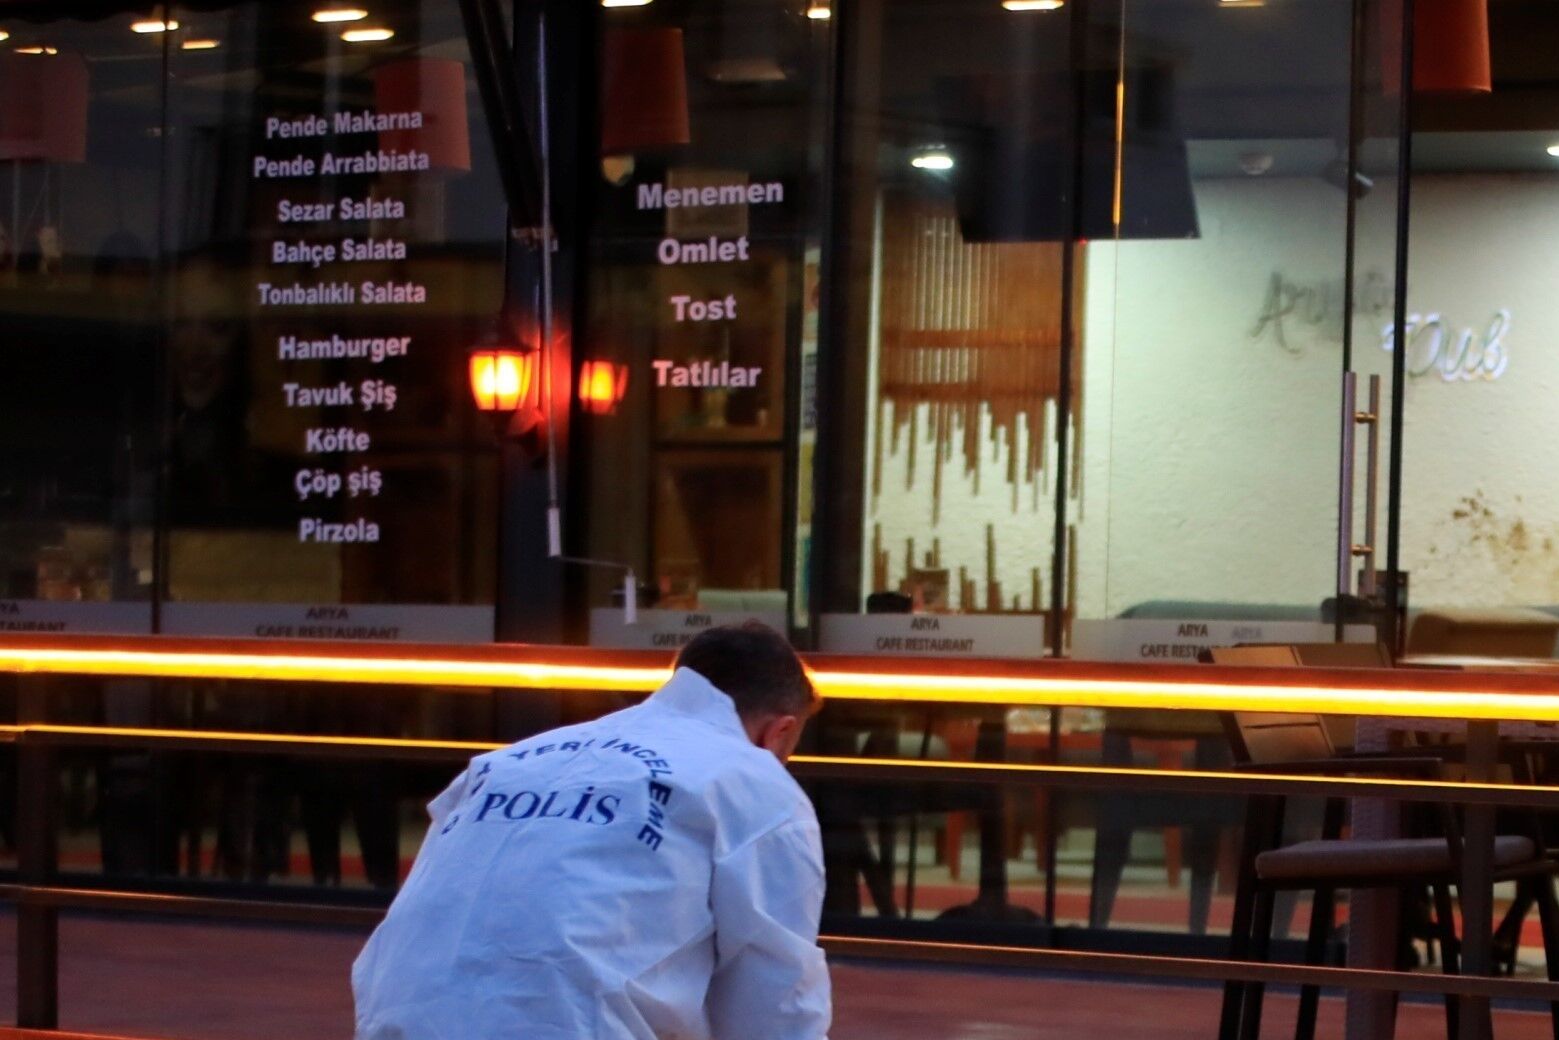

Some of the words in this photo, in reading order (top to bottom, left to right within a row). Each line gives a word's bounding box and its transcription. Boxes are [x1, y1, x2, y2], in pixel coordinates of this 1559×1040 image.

[266, 114, 328, 139] Pende
[334, 110, 422, 135] Makarna
[254, 154, 315, 178] Pende
[320, 150, 429, 176] Arrabbiata
[278, 200, 335, 222] Sezar
[340, 198, 405, 220] Salata
[637, 182, 784, 210] Menemen
[272, 241, 336, 268] Bahçe
[341, 239, 407, 261] Salata
[658, 235, 749, 265] Omlet
[361, 281, 427, 304] Salata
[671, 294, 737, 322] Tost
[278, 335, 411, 363] Hamburger
[283, 381, 354, 407] Tavuk
[360, 380, 398, 412] Şiş
[306, 427, 371, 453] Köfte
[295, 468, 342, 500] Çöp
[299, 518, 380, 542] Pirzola
[306, 606, 350, 621] ARYA
[910, 617, 941, 632] ARYA
[1177, 623, 1209, 638] ARYA
[1140, 643, 1169, 658] CAFE
[474, 786, 621, 826] POLİS
